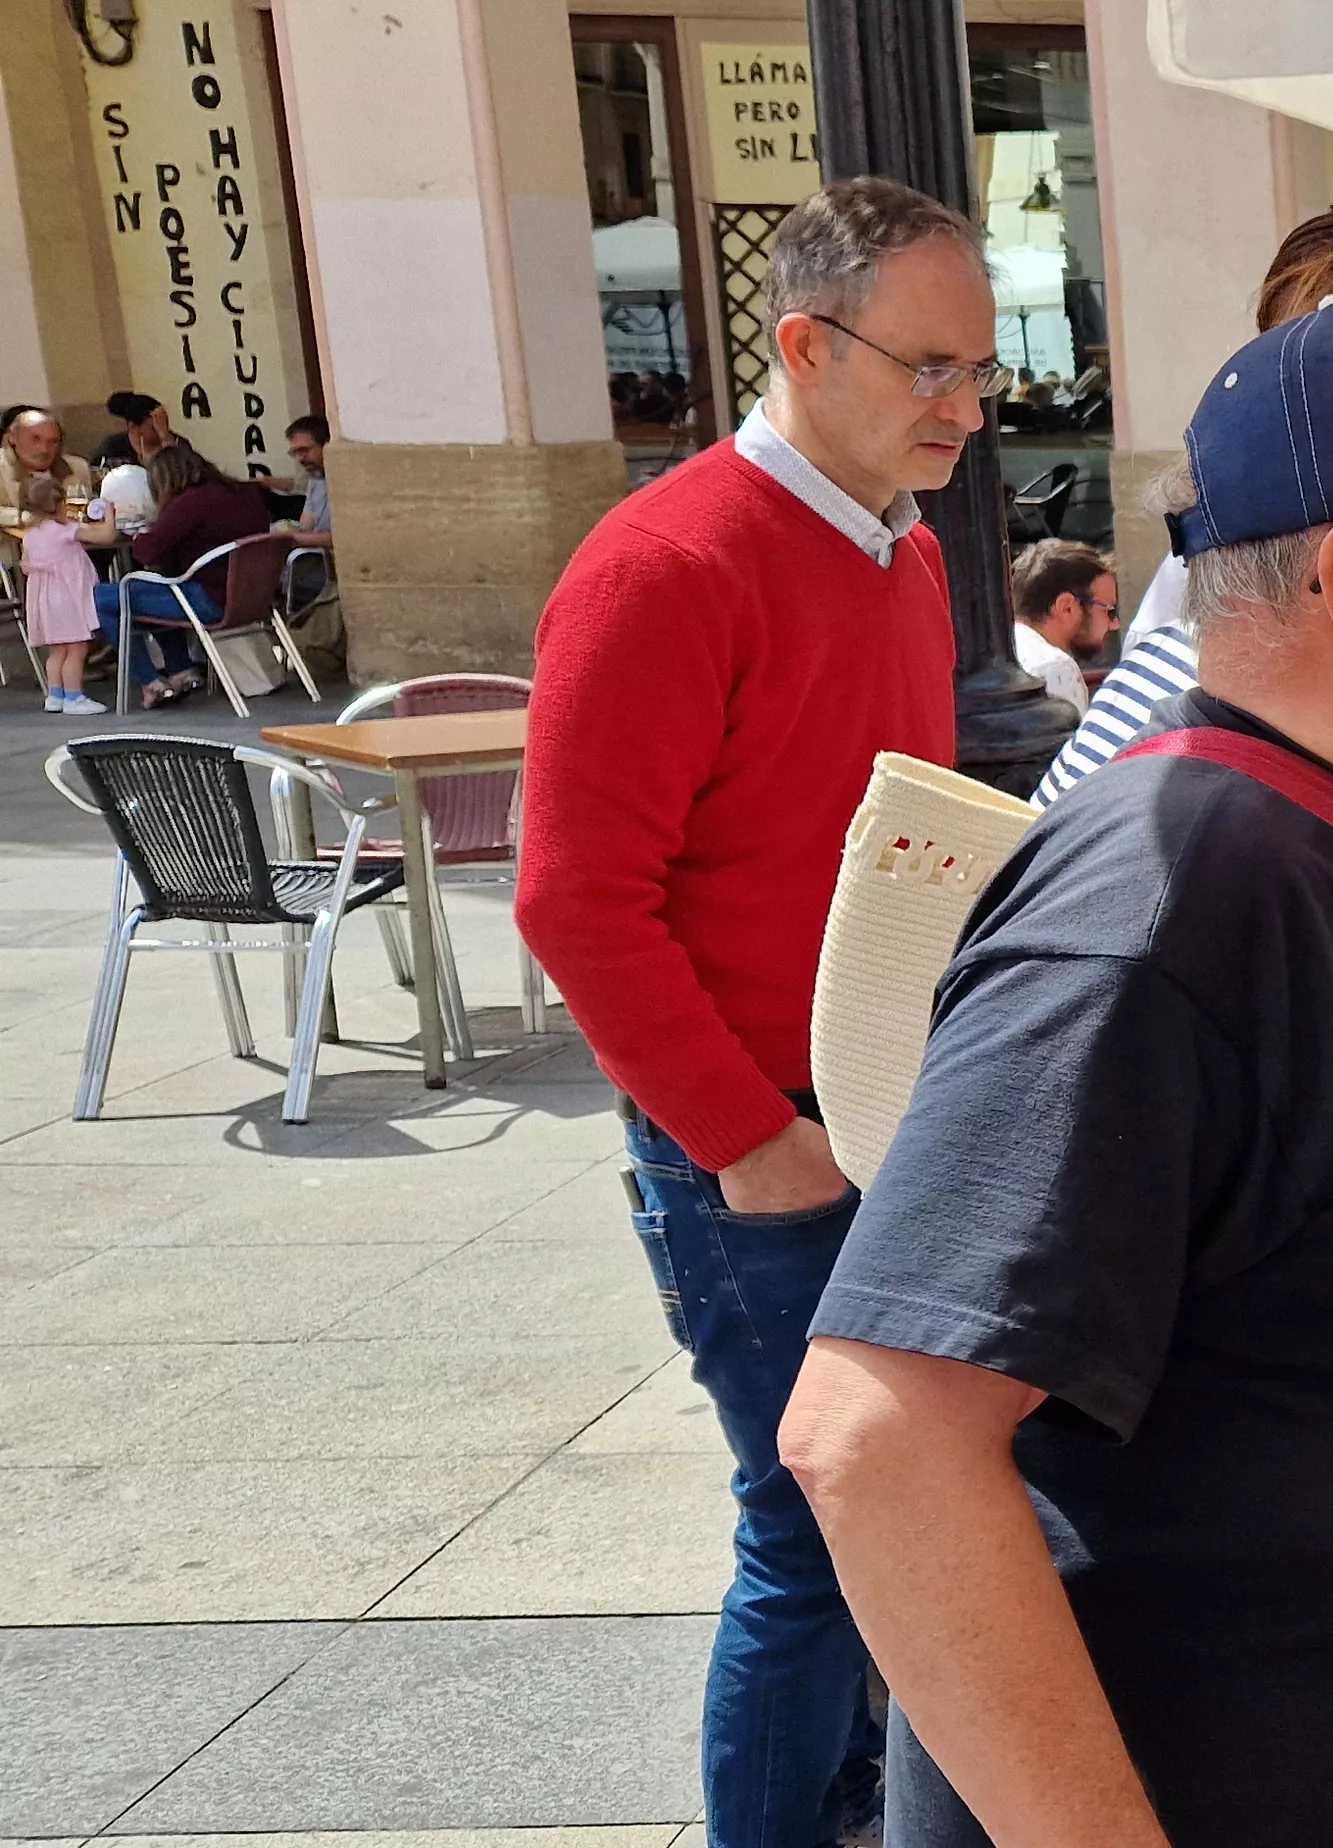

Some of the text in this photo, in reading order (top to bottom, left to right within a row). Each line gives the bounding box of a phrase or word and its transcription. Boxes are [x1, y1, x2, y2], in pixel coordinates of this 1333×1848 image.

[719, 51, 807, 84] LLÁMA
[733, 101, 800, 122] PERO
[735, 134, 776, 161] SIN
[103, 103, 142, 233] SIN
[182, 21, 272, 479] NO HAY CIUDAD
[155, 163, 212, 419] POESIA
